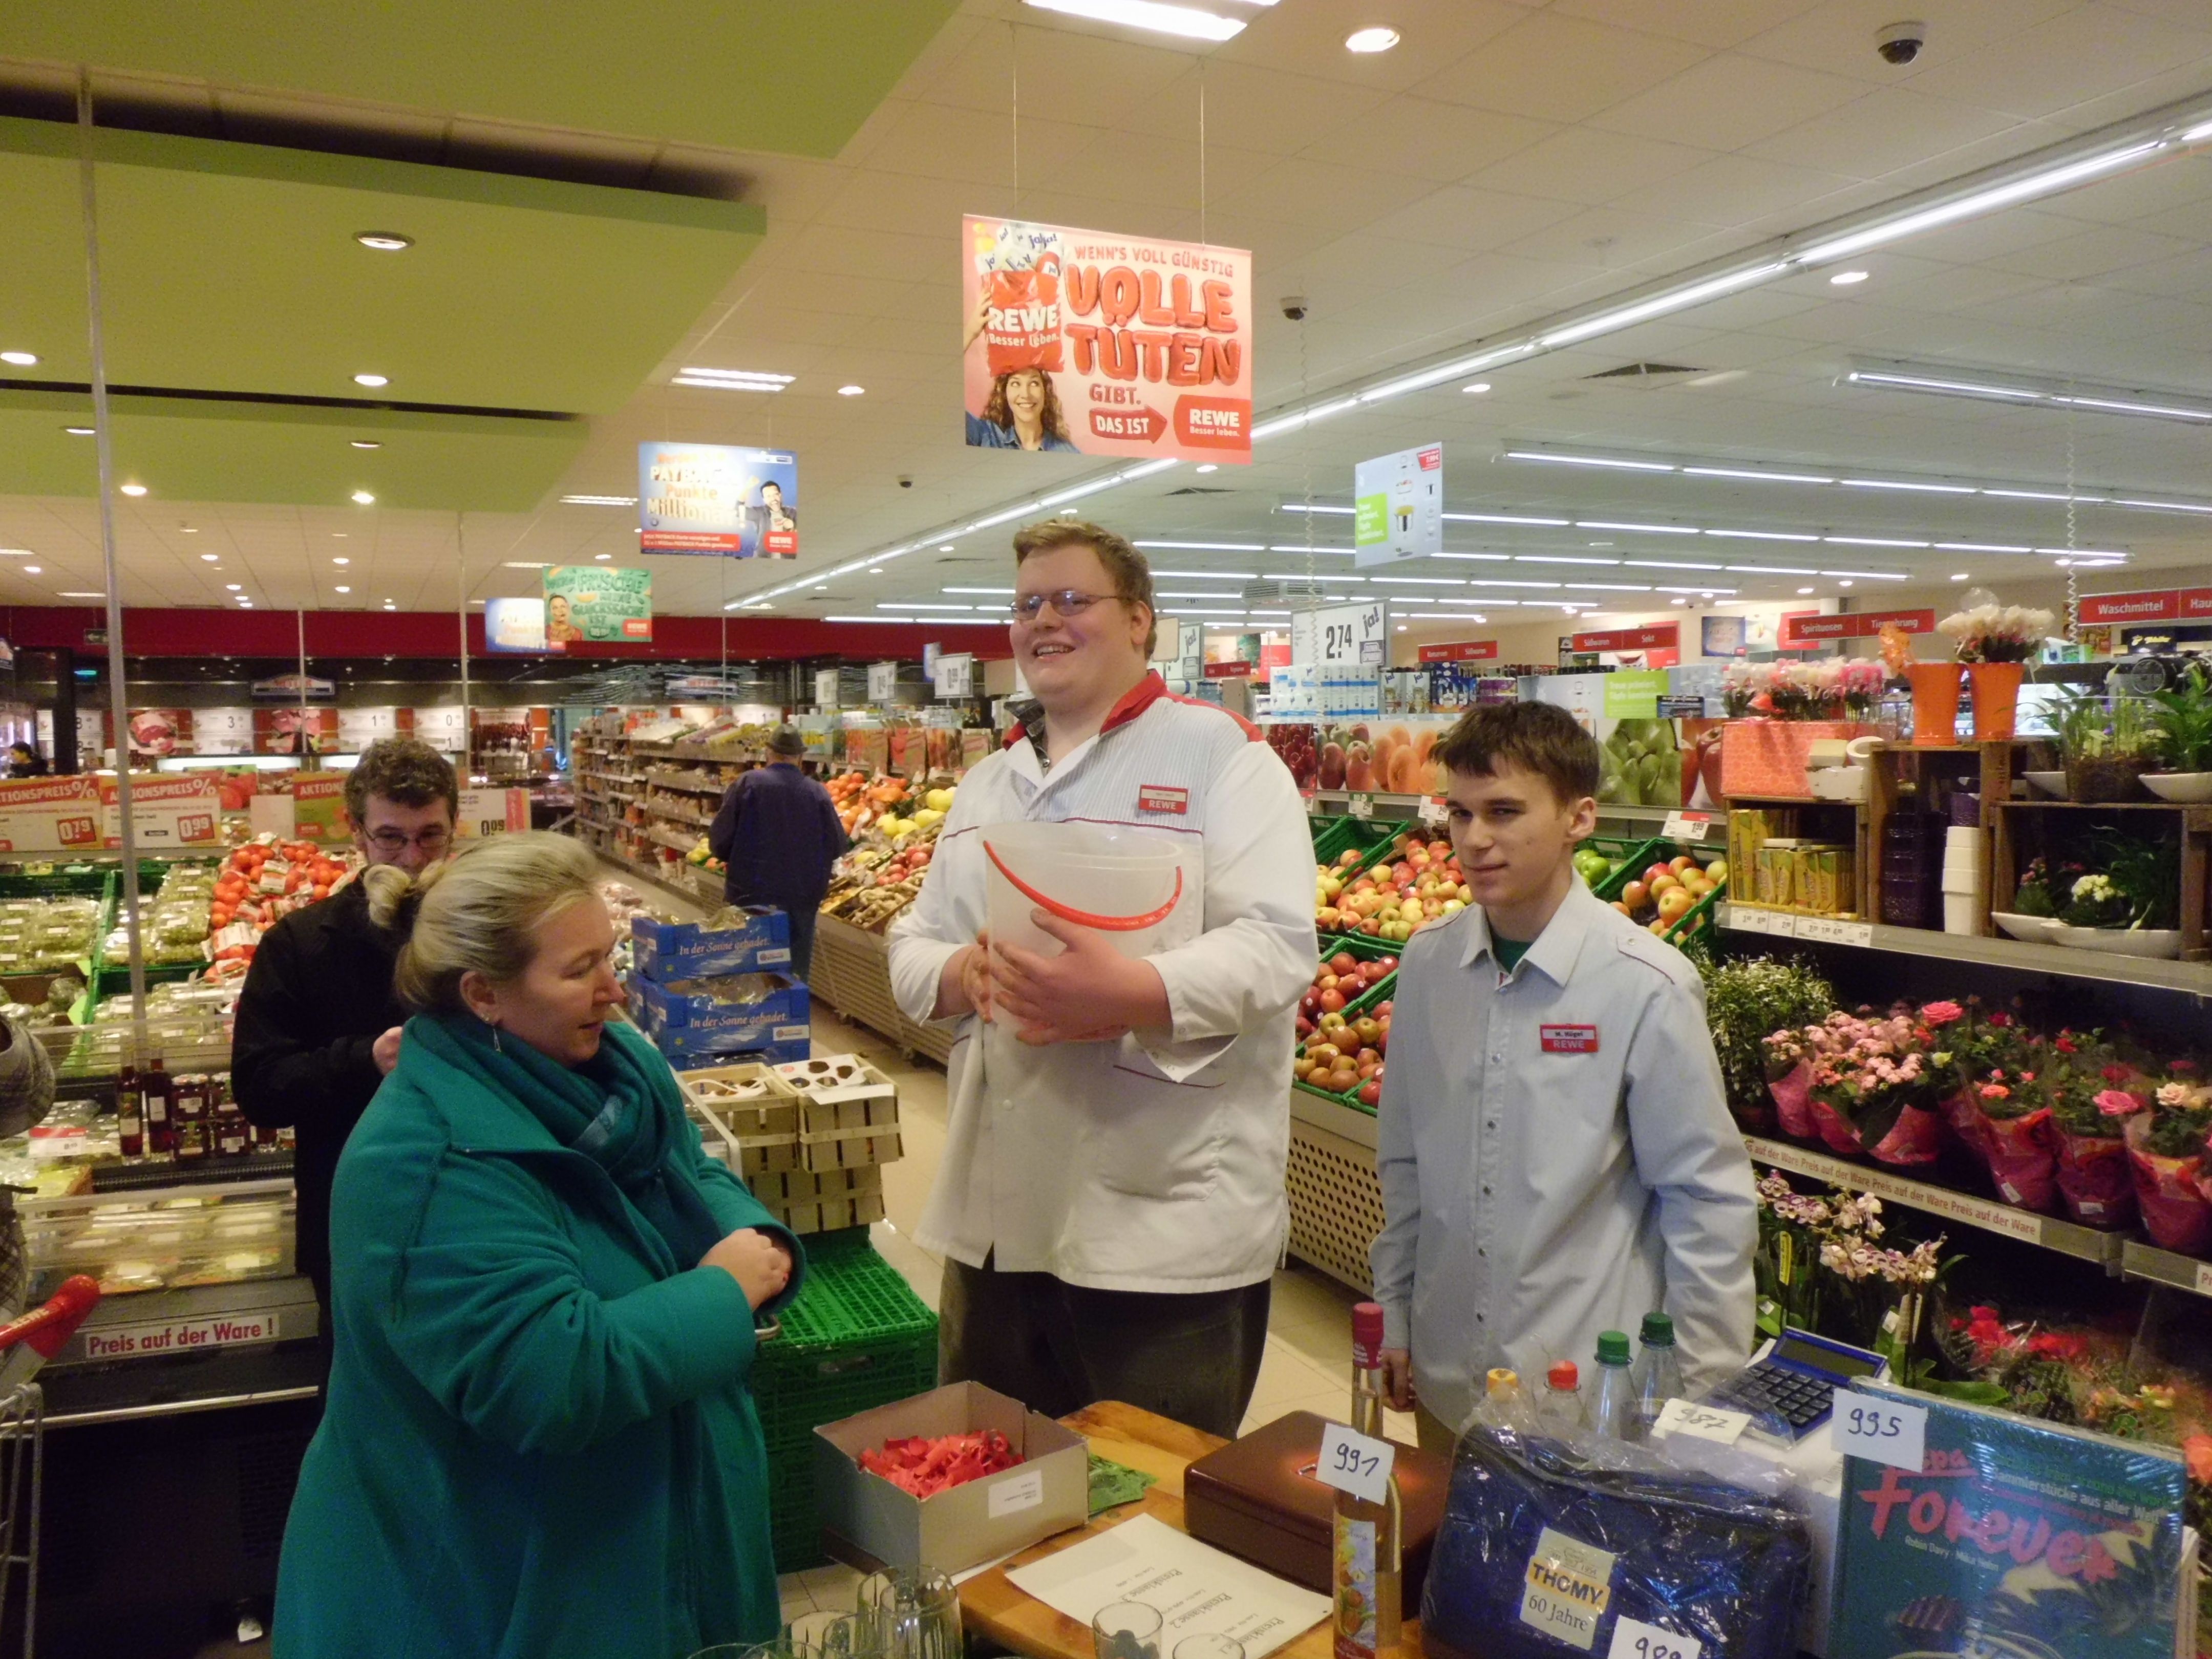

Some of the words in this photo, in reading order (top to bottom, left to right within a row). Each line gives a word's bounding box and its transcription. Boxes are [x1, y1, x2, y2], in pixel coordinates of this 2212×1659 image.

[1075, 246, 1127, 261] WENN'S
[1132, 247, 1167, 265] VOLL
[1172, 250, 1234, 278] GÜNSTIG
[1064, 263, 1238, 333] VOLLE
[988, 307, 1060, 332] REWE
[988, 333, 1025, 348] Besser
[1064, 313, 1242, 387] TÜTEN
[1089, 383, 1142, 406] GIBT.
[1096, 415, 1123, 434] DAS
[1126, 418, 1150, 435] IST
[1189, 408, 1240, 428] REWE
[1189, 426, 1215, 436] Besser
[1216, 427, 1240, 437] leben.
[2098, 600, 2164, 615] Waschmittel
[1362, 606, 1380, 639] ja!
[1800, 623, 1843, 634] Spirituosen
[1326, 624, 1352, 660] 2.74
[1641, 634, 1655, 643] Sekt
[1148, 800, 1176, 810] REWE
[58, 820, 92, 840] 0.79
[179, 816, 210, 838] 0.99
[481, 820, 505, 837] 0.09
[679, 946, 690, 956] In
[691, 941, 705, 954] der
[706, 941, 733, 952] Sonne
[690, 1017, 700, 1028] In
[702, 1014, 717, 1027] der
[719, 1014, 748, 1026] Sonne
[1553, 1039, 1585, 1049] REWE
[1754, 1146, 1766, 1156] auf
[1768, 1148, 1780, 1160] der
[1781, 1152, 1799, 1166] Ware
[1801, 1157, 1819, 1172] Preis
[1821, 1165, 1835, 1176] auf
[1836, 1167, 1848, 1180] der
[1850, 1172, 1870, 1187] Ware
[1872, 1178, 1893, 1194] Preis
[1894, 1186, 1908, 1197] auf
[1910, 1188, 1924, 1202] der
[1926, 1194, 1949, 1210] Ware
[1951, 1201, 1973, 1217] Preis
[1975, 1209, 1991, 1221] auf
[1992, 1213, 2010, 1227] der
[2011, 1218, 2036, 1236] Ware
[89, 1335, 135, 1356] Preis
[140, 1332, 172, 1350] auf
[177, 1326, 208, 1345] der
[213, 1322, 262, 1341] Ware
[1847, 1407, 1902, 1438] 995
[1333, 1441, 1379, 1478] 991
[2079, 1493, 2101, 1508] aus
[1859, 1466, 2119, 1584] Forever
[1533, 1562, 1604, 1605] THOMY
[1180, 1592, 1233, 1623] Preisklasse
[1528, 1594, 1547, 1614] 60
[1546, 1603, 1588, 1632] Jahre
